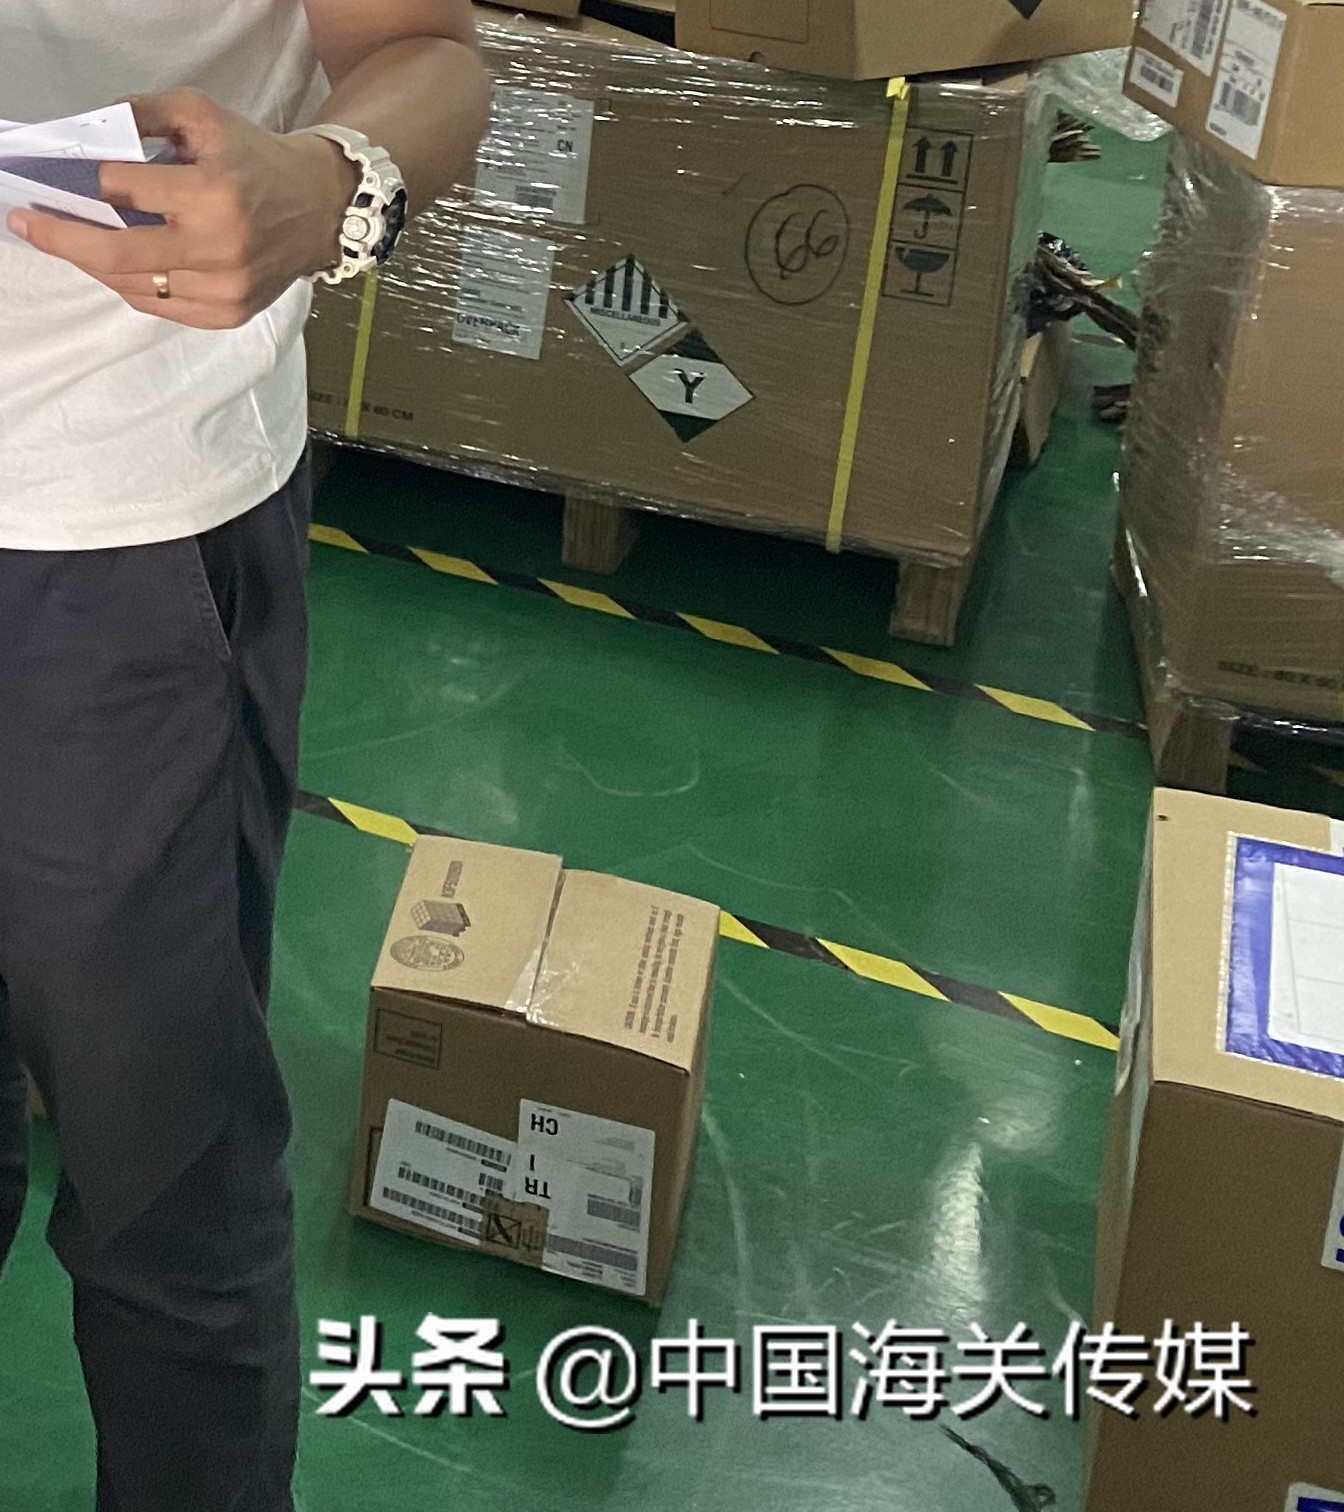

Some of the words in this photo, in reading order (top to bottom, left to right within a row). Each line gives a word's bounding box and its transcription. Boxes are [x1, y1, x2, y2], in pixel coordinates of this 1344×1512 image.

[673, 367, 706, 404] Y
[530, 1113, 559, 1136] CH
[524, 1176, 552, 1199] TR
